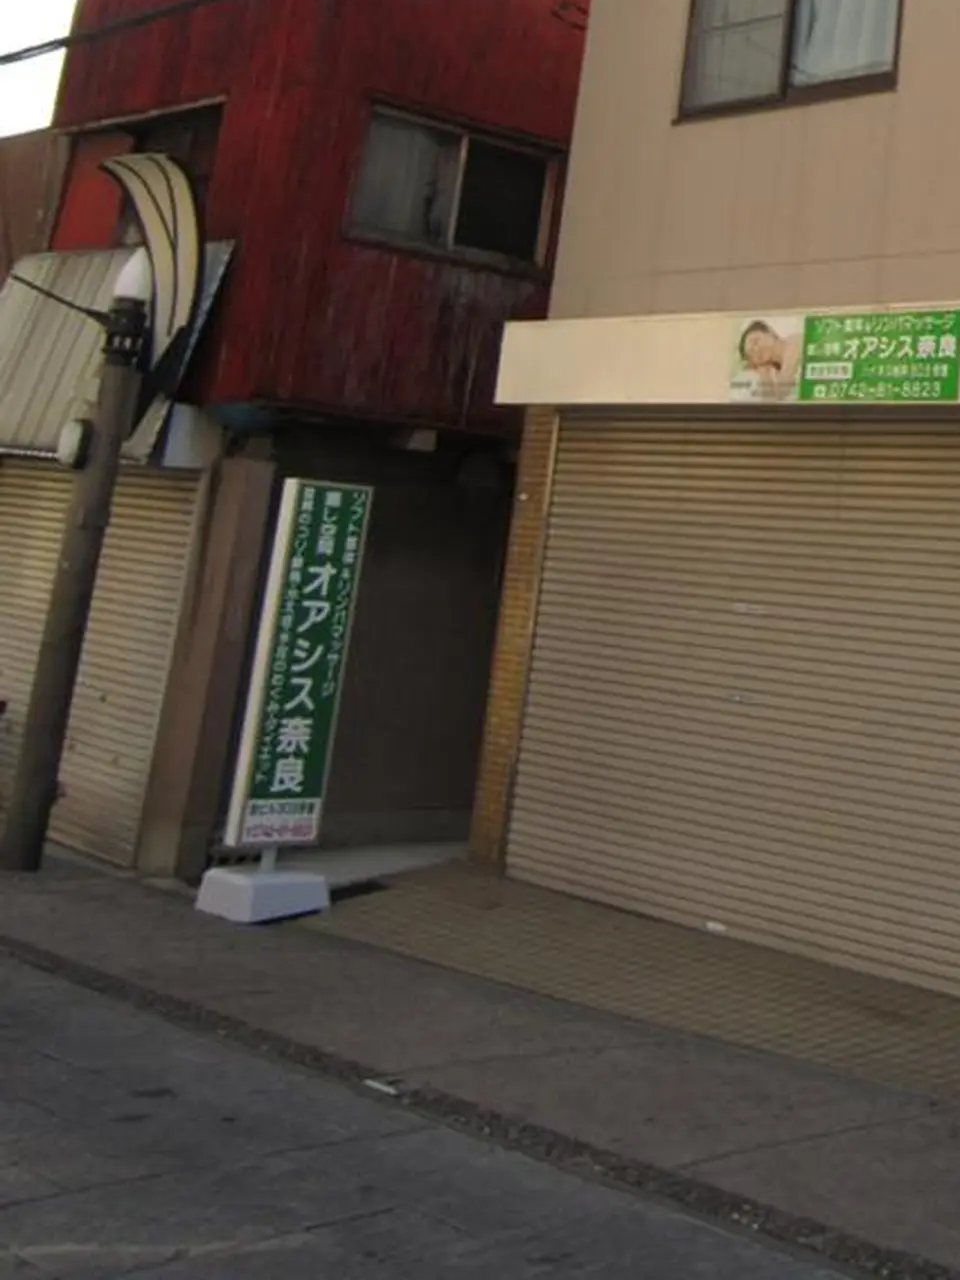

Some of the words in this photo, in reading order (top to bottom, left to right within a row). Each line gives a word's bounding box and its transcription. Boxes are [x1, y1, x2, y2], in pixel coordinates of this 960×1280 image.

[844, 334, 957, 359] オアシス奈良
[269, 562, 338, 793] オアシス奈良
